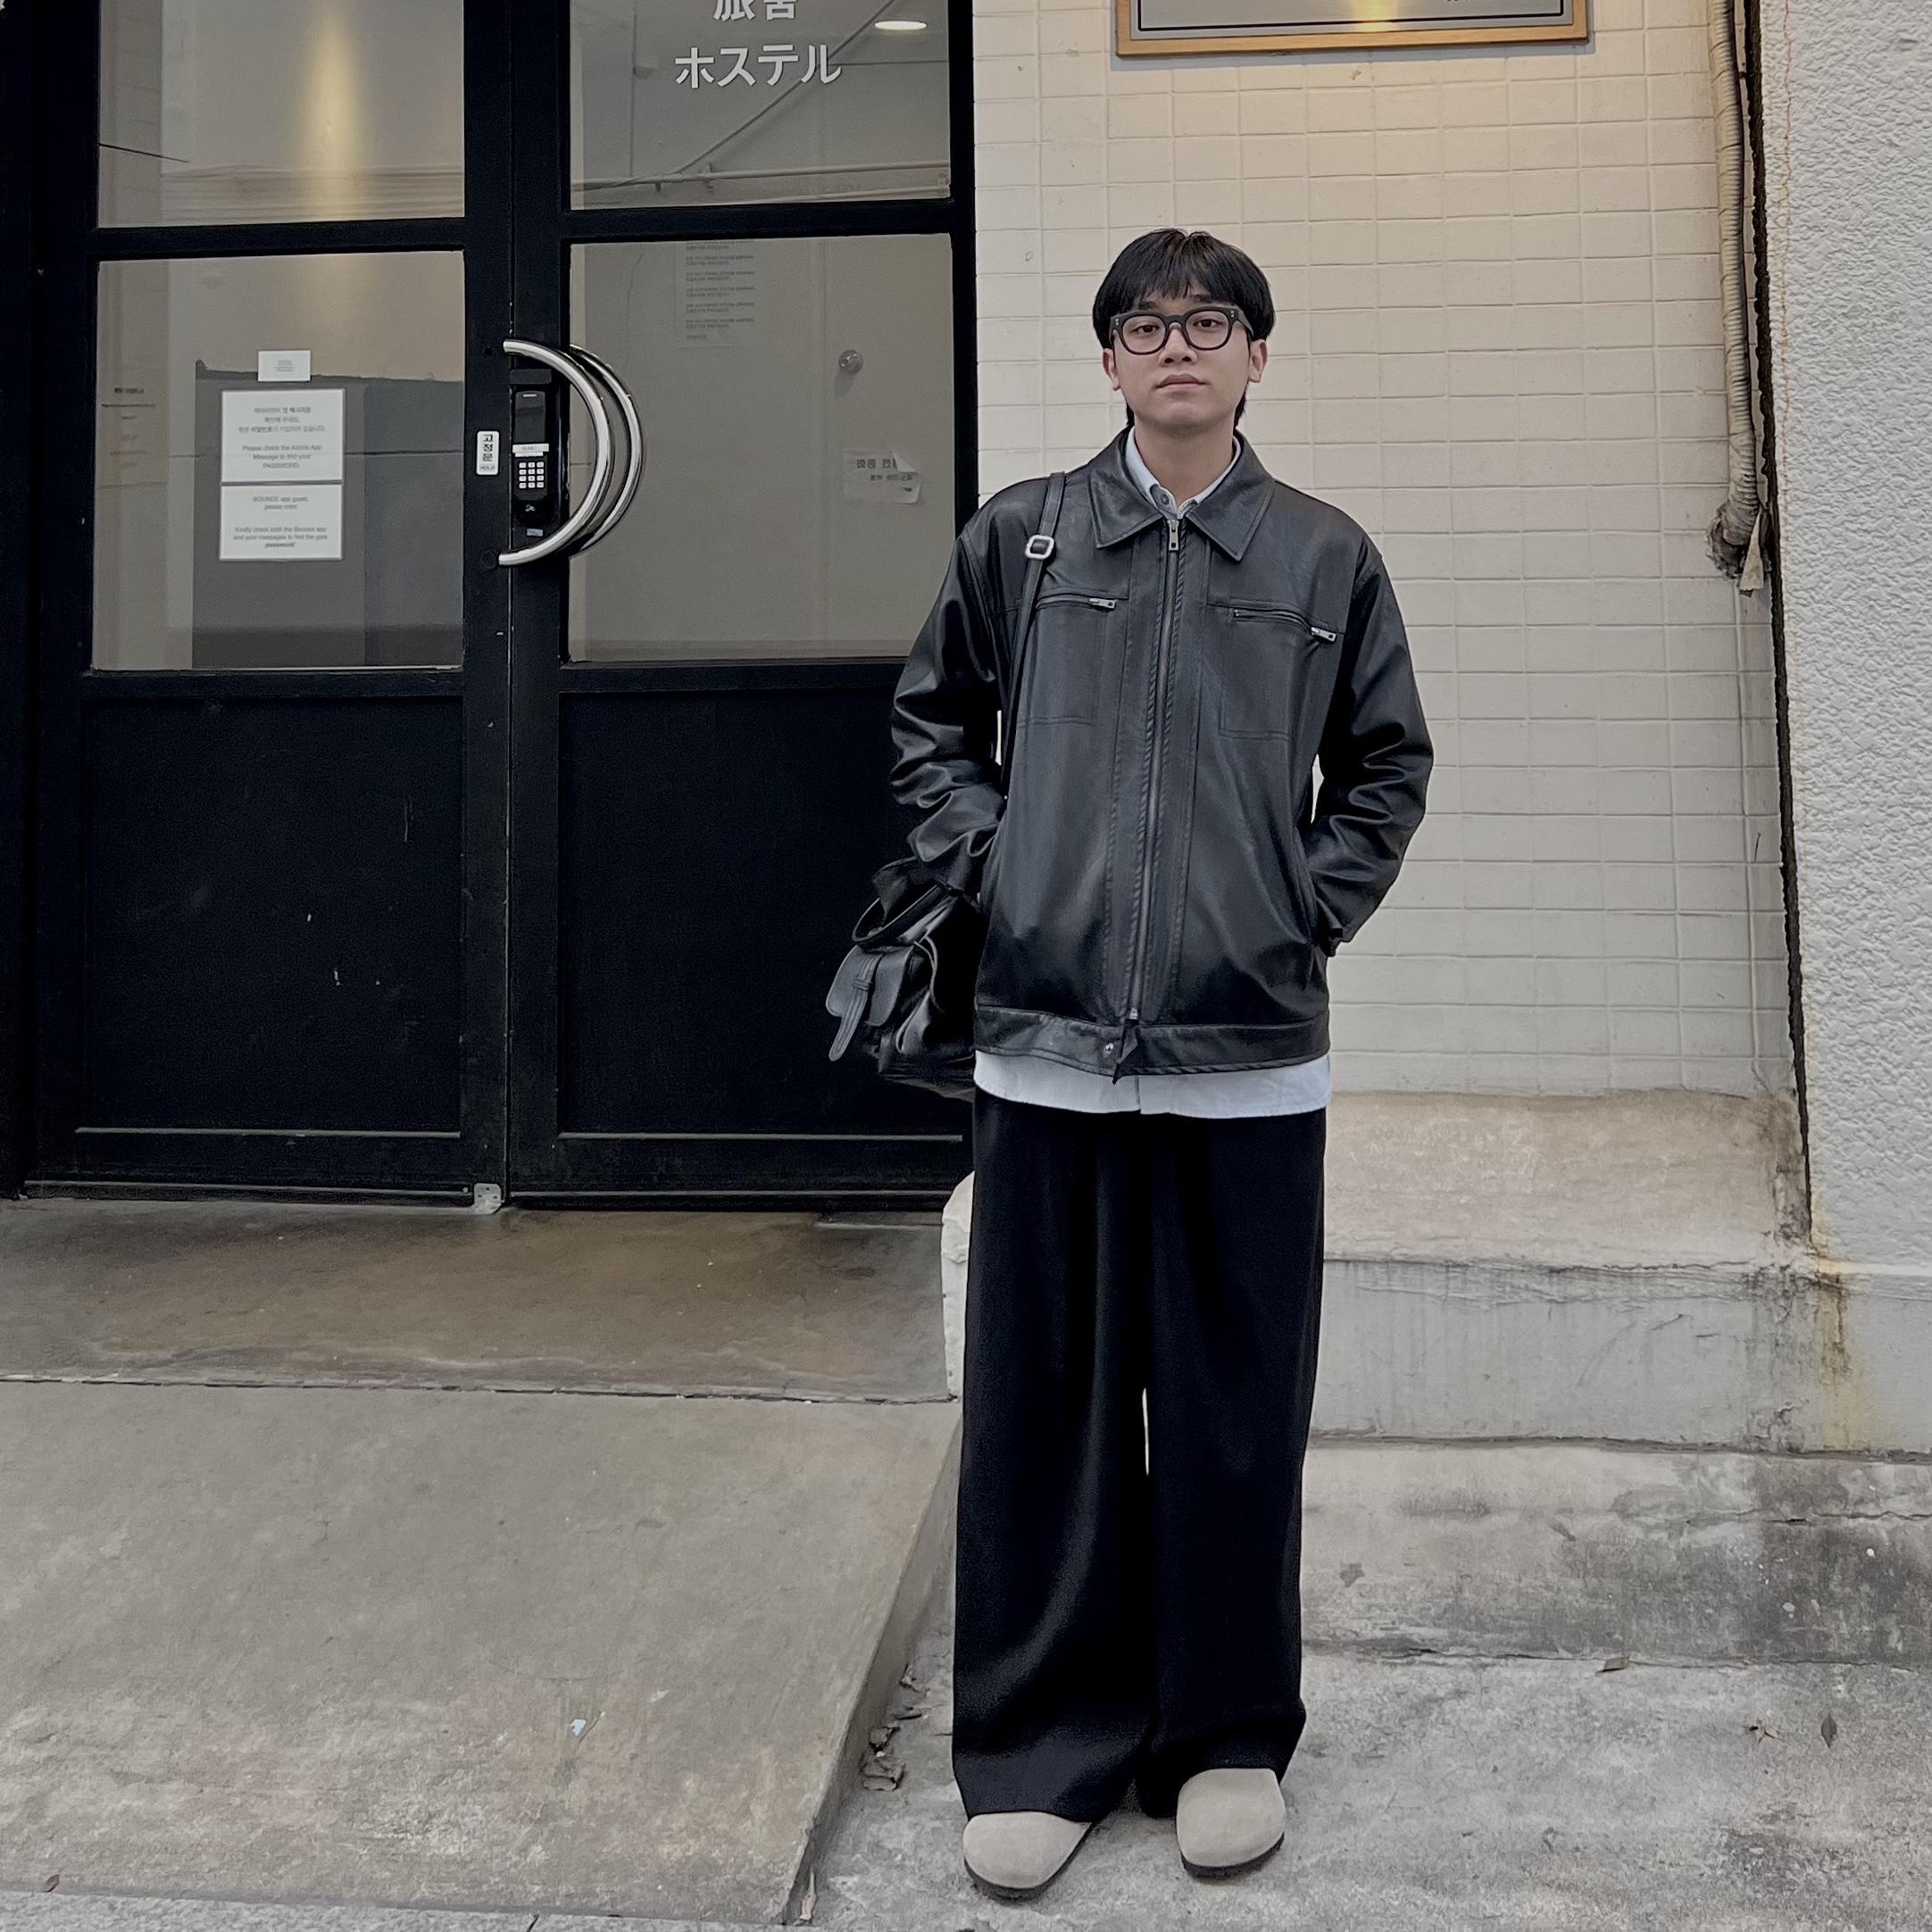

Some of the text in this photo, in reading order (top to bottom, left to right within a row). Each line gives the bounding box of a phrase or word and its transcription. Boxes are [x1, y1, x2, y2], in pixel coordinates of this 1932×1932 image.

[674, 44, 842, 89] ホステル
[482, 434, 493, 462] 고정문
